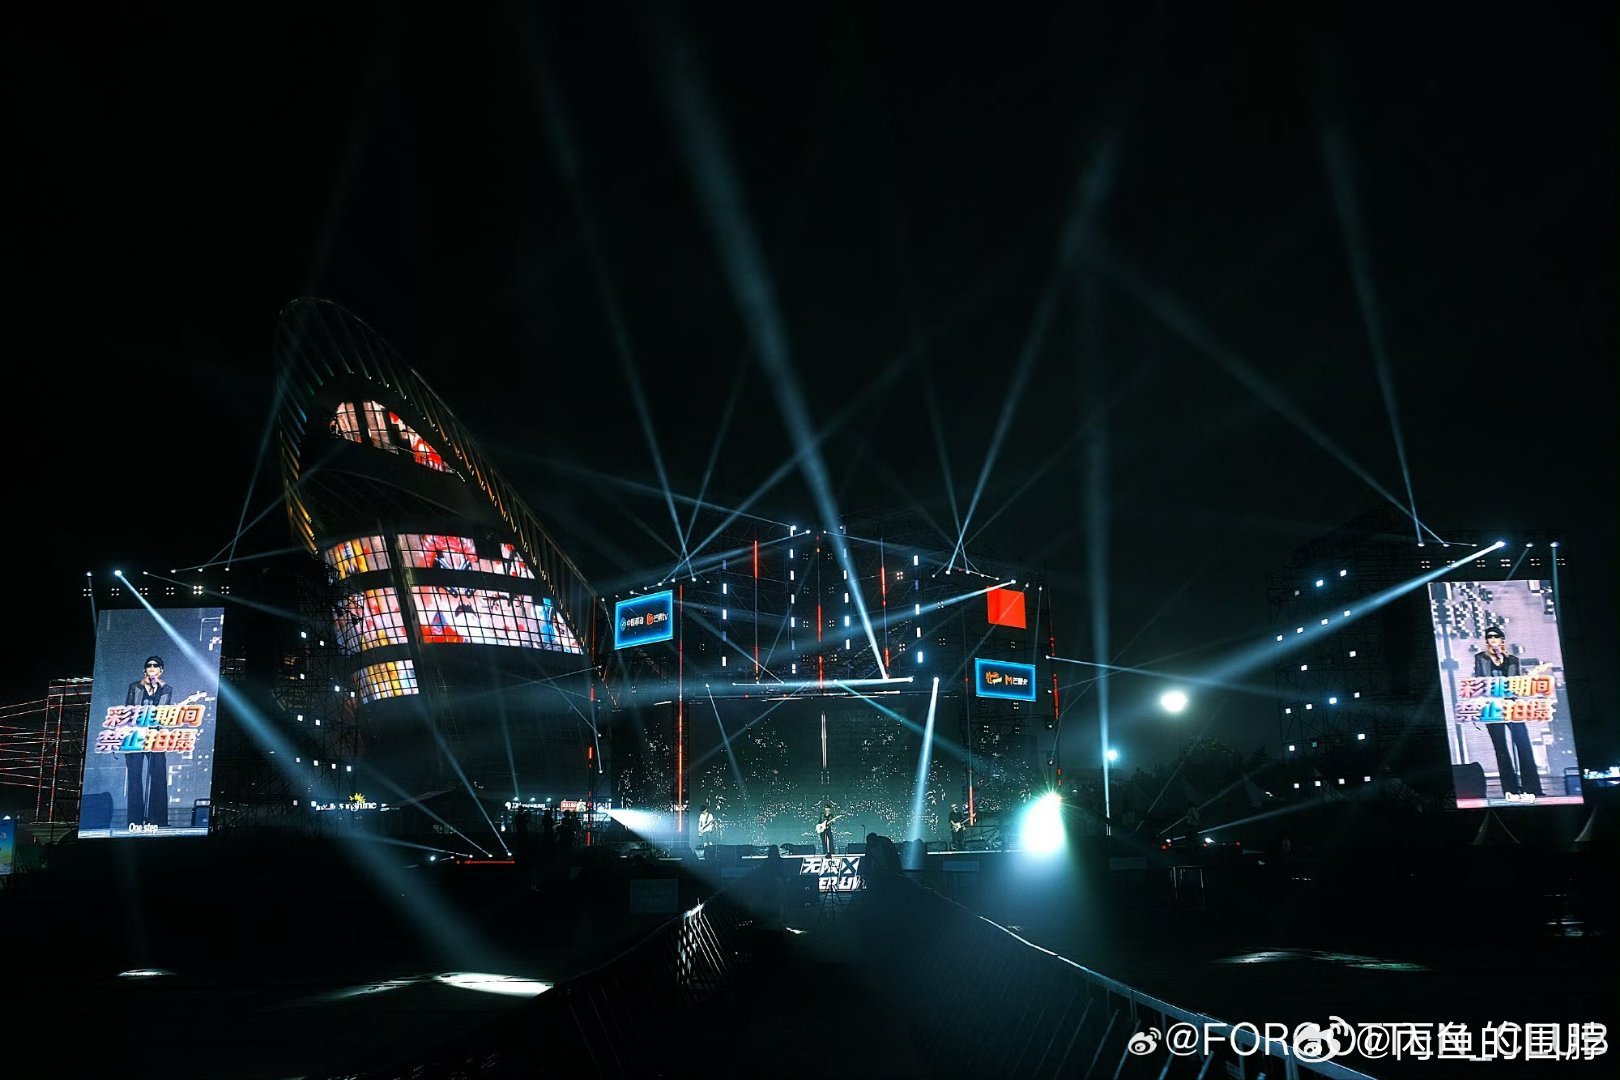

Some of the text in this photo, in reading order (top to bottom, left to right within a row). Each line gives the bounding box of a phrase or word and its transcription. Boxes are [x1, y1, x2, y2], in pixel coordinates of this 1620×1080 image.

[1458, 675, 1554, 698] 彩排期间
[103, 705, 205, 728] 彩排期间
[1455, 699, 1554, 722] 禁止拍摄
[95, 728, 197, 753] 禁止拍摄
[129, 822, 159, 834] One step
